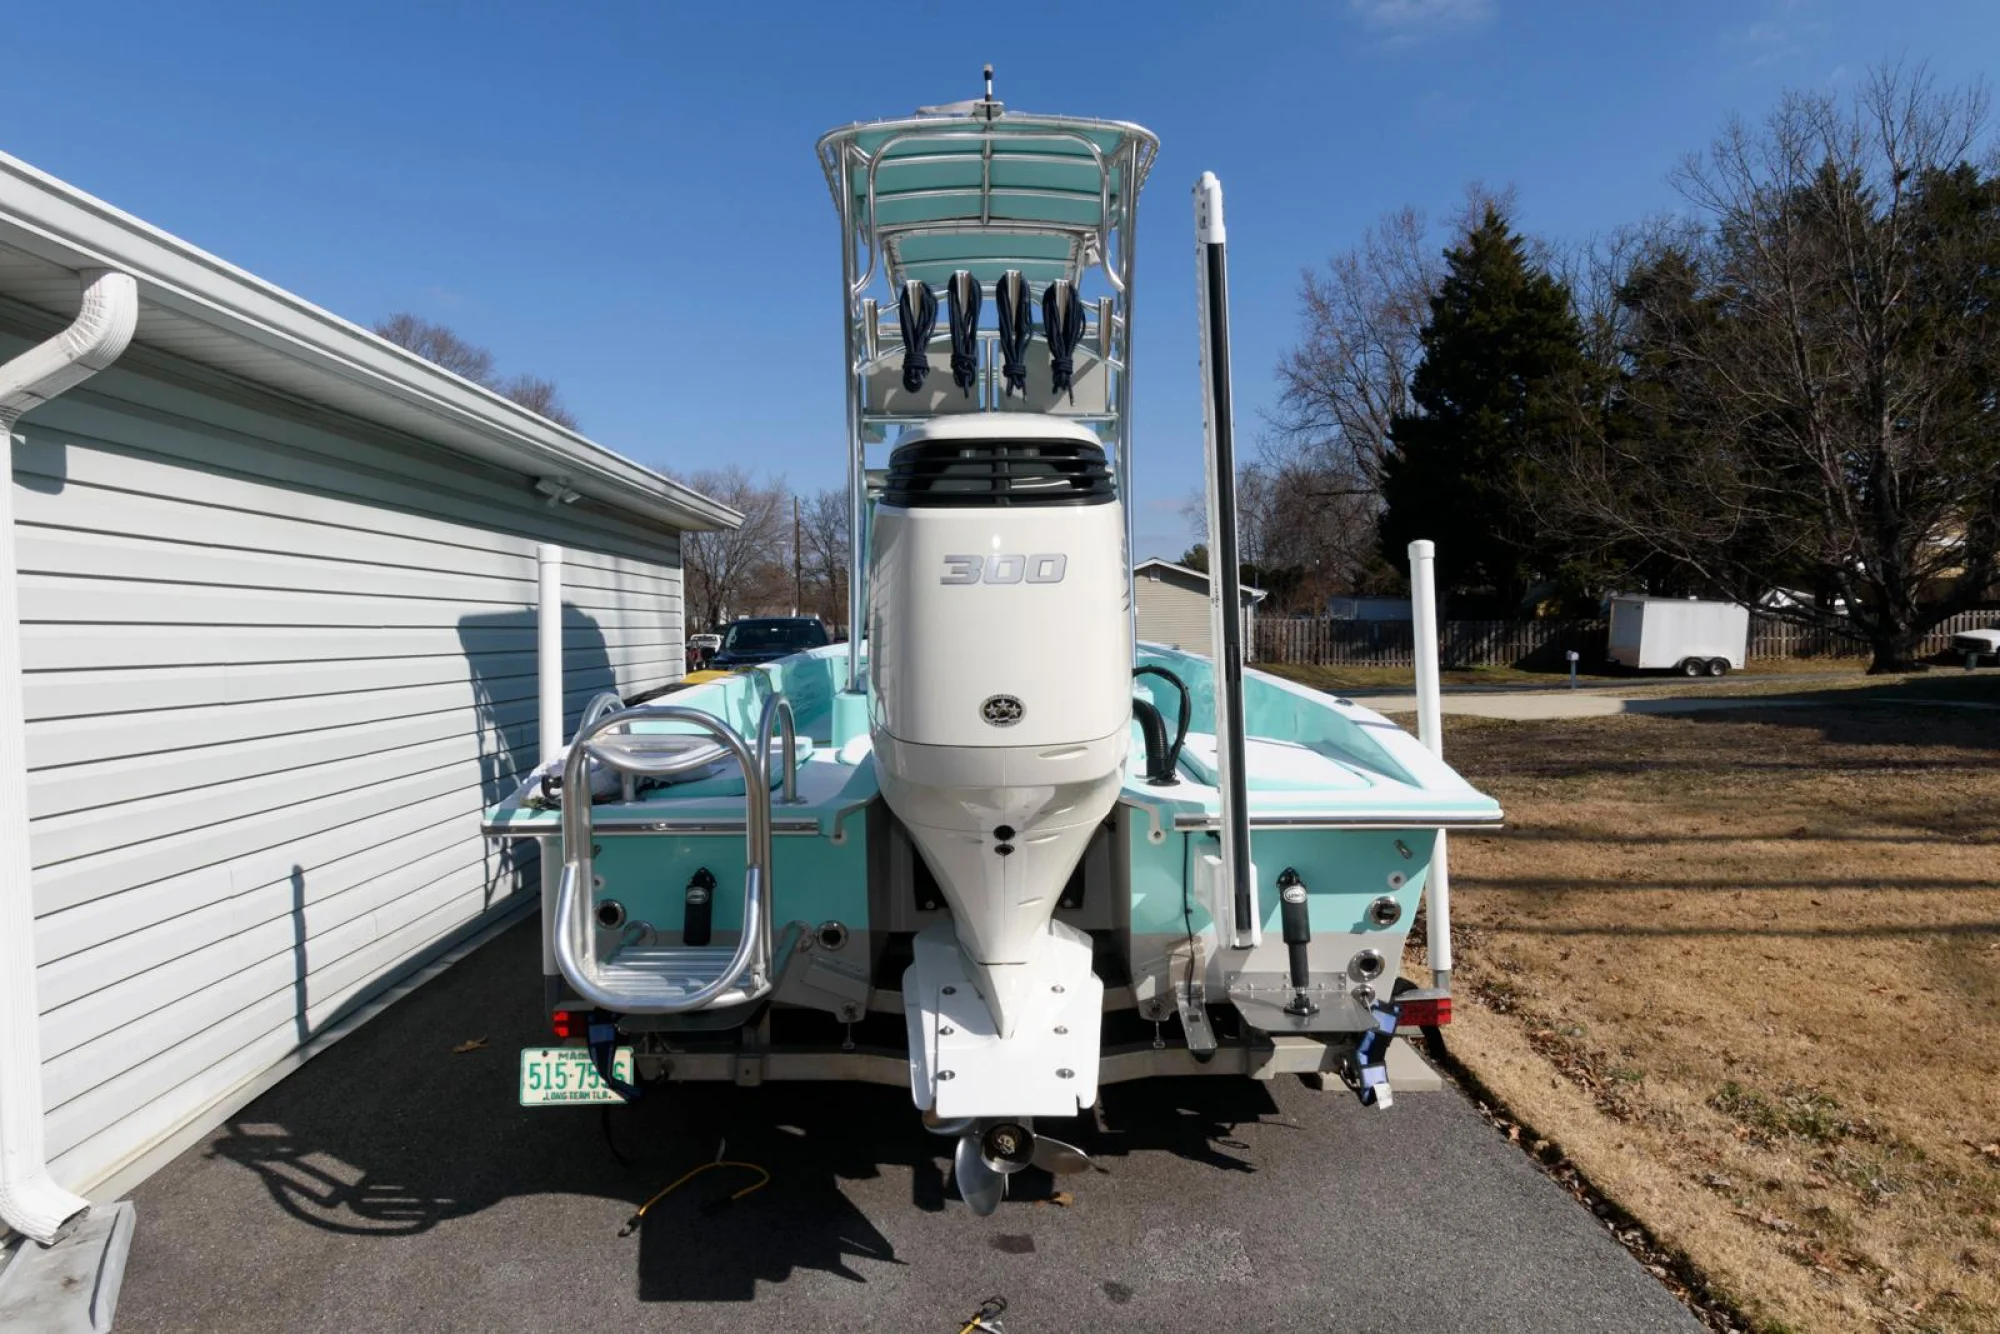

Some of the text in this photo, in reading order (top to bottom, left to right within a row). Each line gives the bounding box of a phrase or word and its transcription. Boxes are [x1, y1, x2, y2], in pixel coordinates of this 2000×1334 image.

[939, 554, 1068, 585] 300
[529, 1061, 626, 1090] 515-756
[545, 1091, 567, 1100] LONG
